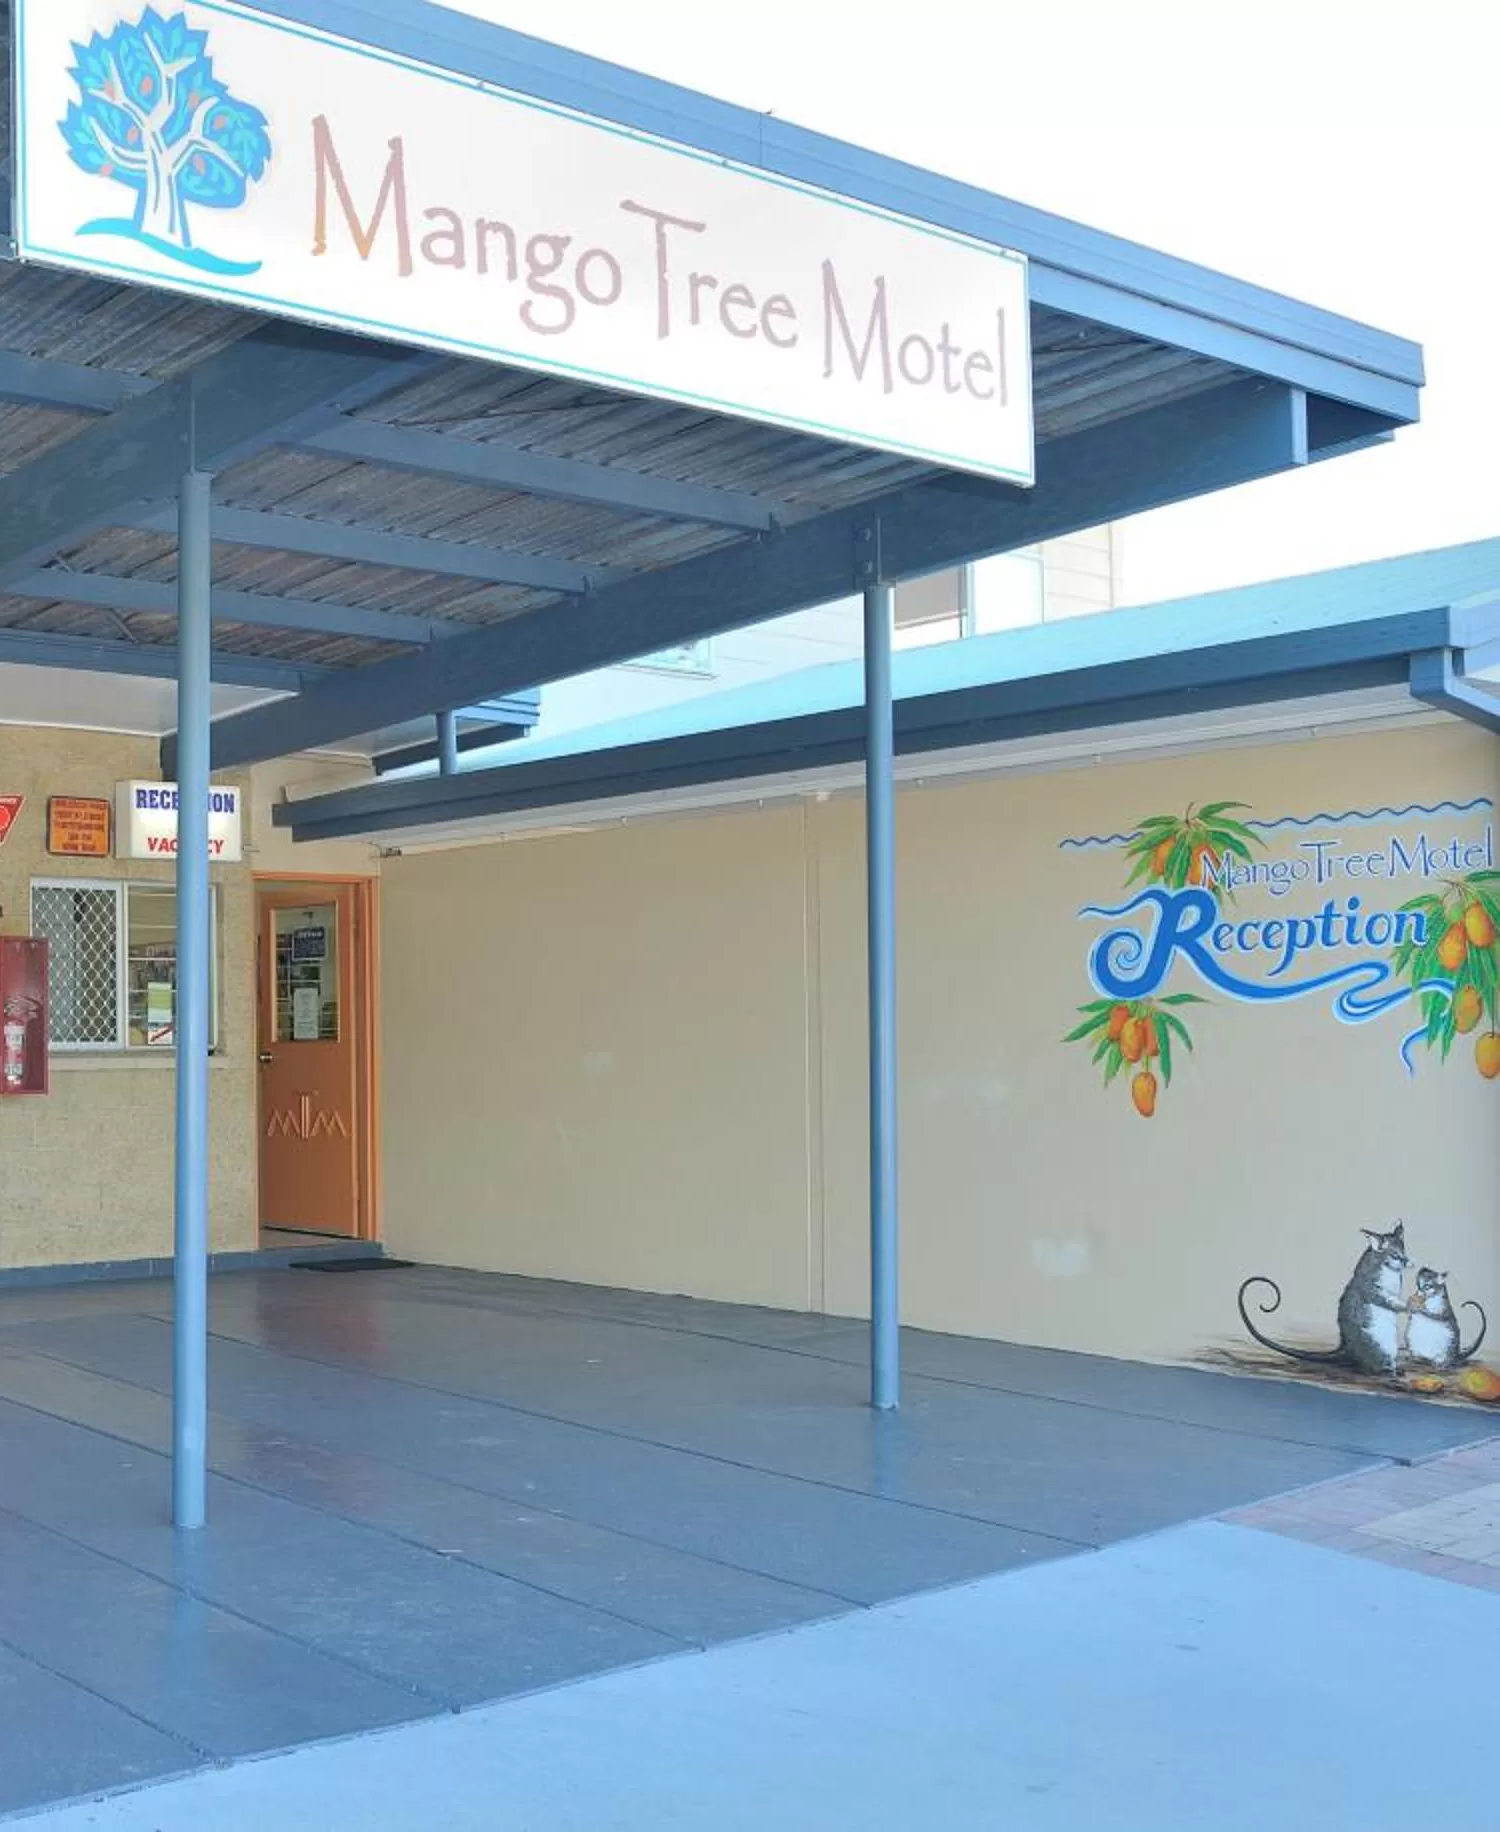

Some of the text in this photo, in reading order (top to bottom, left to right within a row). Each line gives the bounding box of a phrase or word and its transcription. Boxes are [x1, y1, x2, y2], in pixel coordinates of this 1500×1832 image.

[309, 113, 1009, 408] Mango Tree Motel
[135, 788, 235, 813] RECEION
[1088, 887, 1428, 1000] Reception
